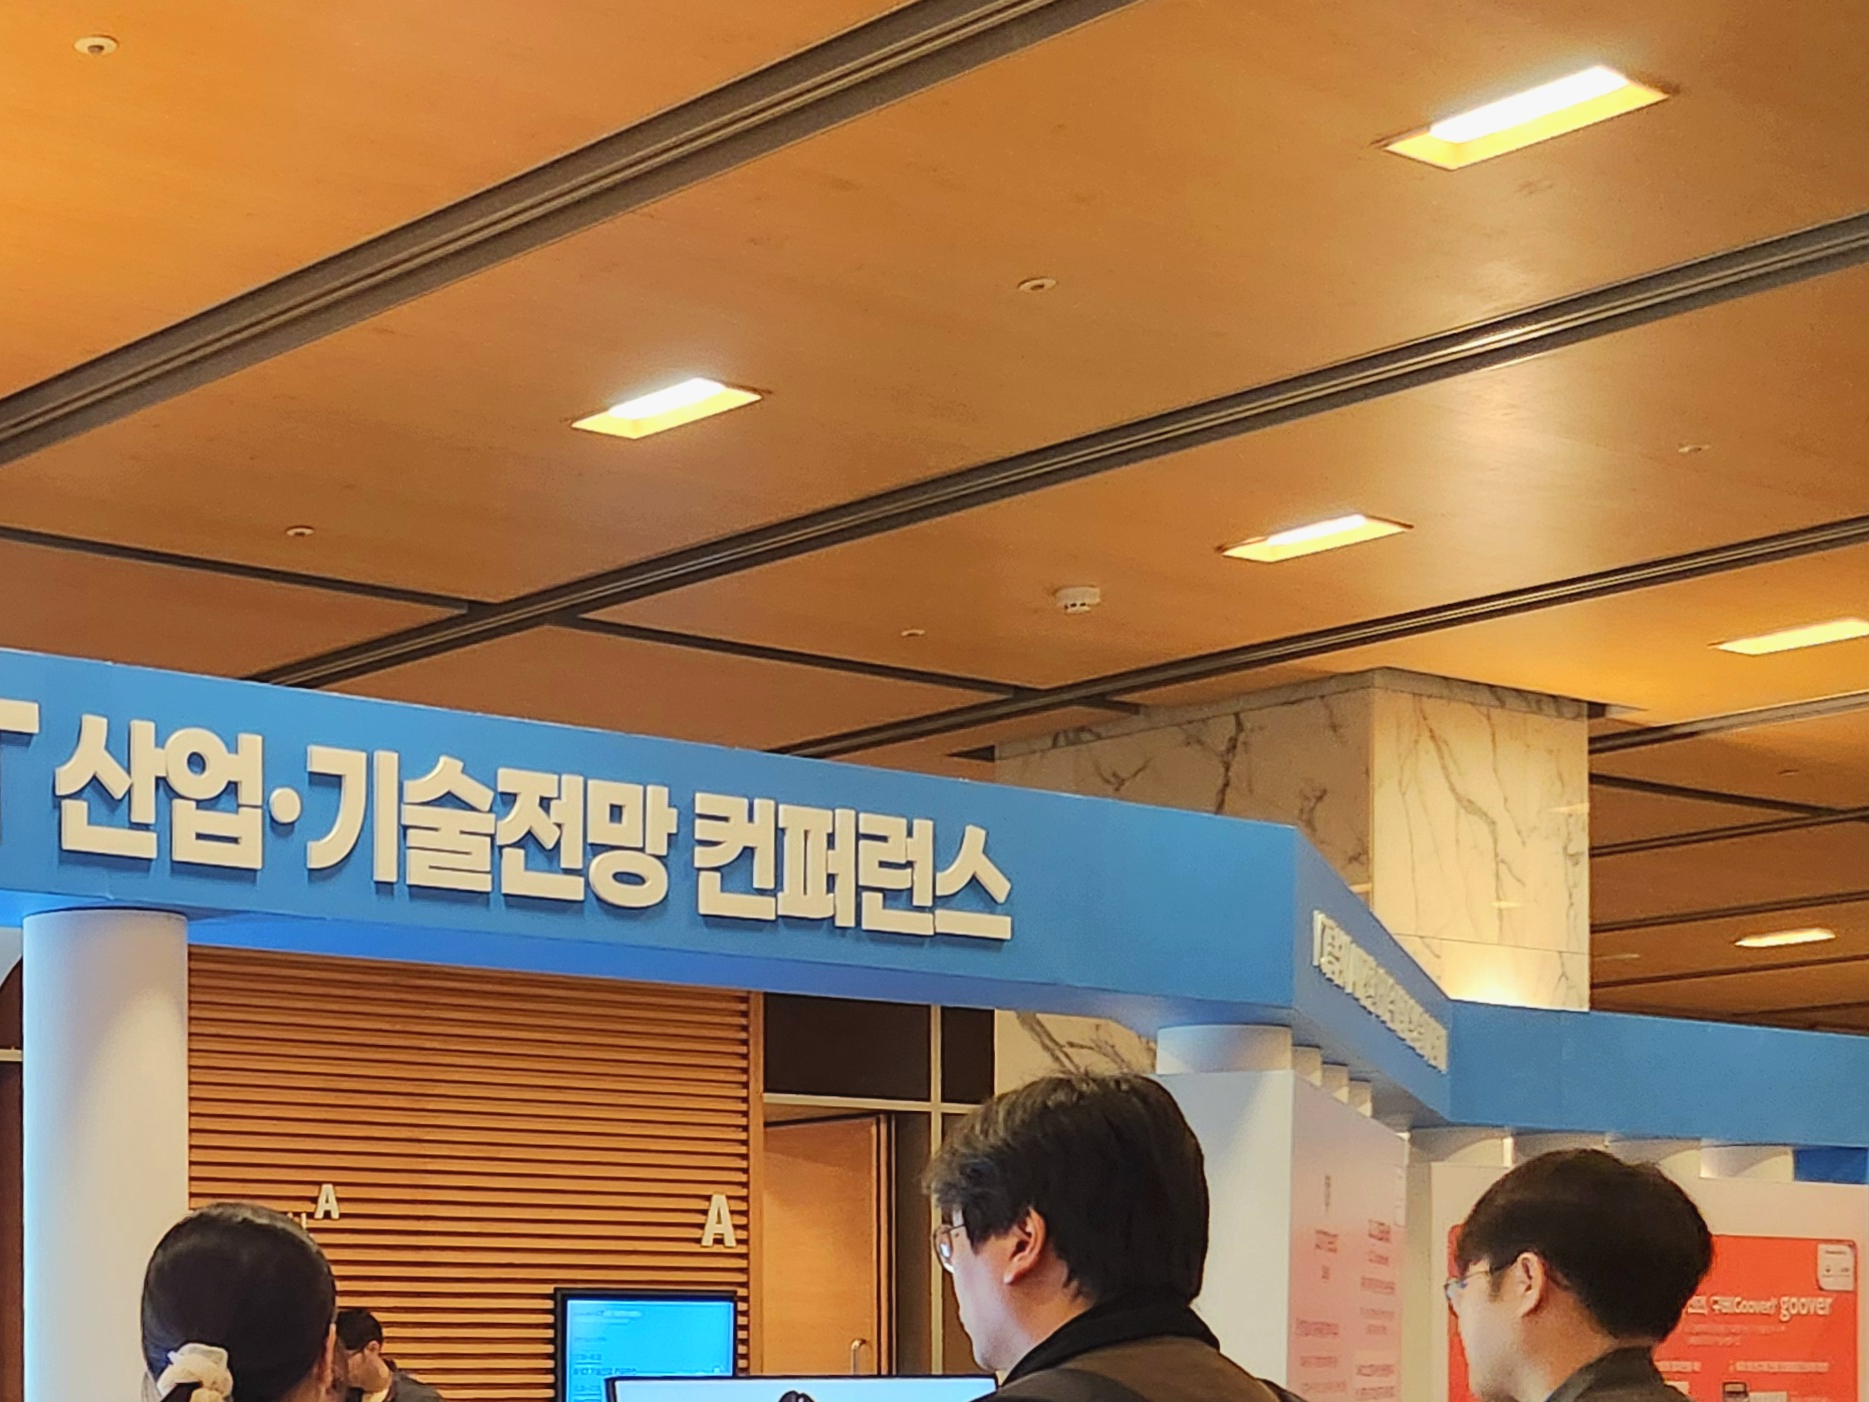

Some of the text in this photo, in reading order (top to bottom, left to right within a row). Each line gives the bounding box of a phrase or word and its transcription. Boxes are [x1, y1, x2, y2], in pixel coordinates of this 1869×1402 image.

[55, 713, 679, 907] 산업·기술전망
[693, 791, 1012, 939] 컨퍼런스
[314, 1184, 340, 1219] A
[700, 1193, 738, 1248] A
